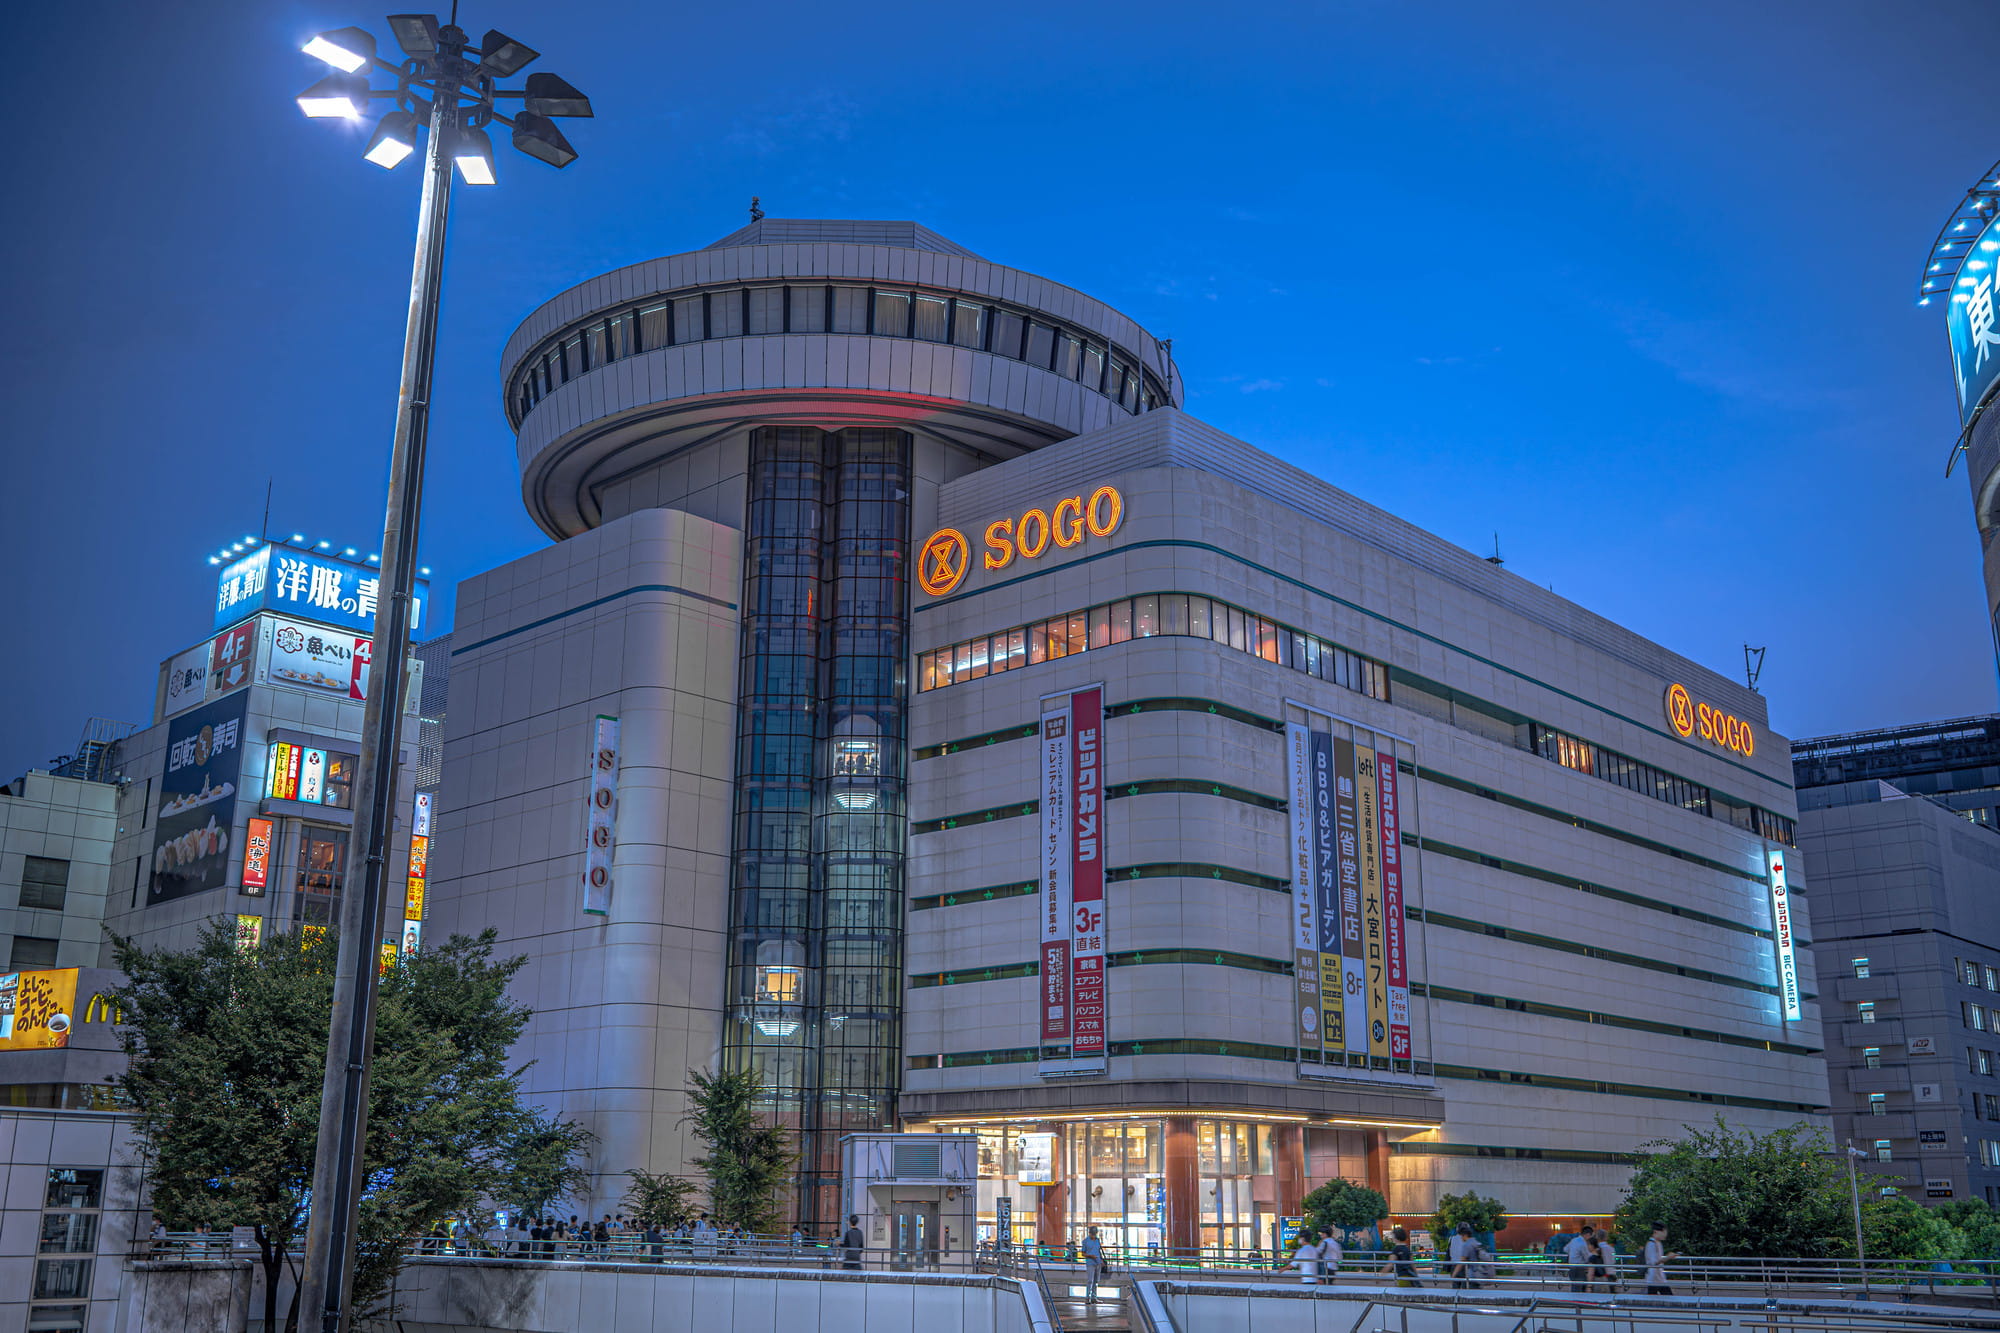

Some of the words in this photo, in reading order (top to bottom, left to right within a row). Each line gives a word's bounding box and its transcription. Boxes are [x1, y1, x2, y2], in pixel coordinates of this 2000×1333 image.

[984, 485, 1124, 570] SOGO
[218, 566, 266, 612] 洋服の青山
[221, 631, 246, 664] 4F
[308, 635, 352, 660] 魚べい
[184, 667, 206, 690] 魚べい
[1698, 702, 1754, 757] SOGO
[169, 735, 198, 773] 回転
[211, 718, 240, 757] 寿司
[1078, 728, 1097, 862] ビックカメラ
[590, 749, 616, 888] SOGO
[1381, 762, 1397, 864] ビックカメラ
[248, 836, 266, 873] 北海道
[411, 848, 424, 873] 北海道
[1317, 751, 1336, 949] BBQ&ビアガーデン
[1339, 804, 1360, 941] 三省堂書店
[1076, 907, 1101, 933] 3F
[1777, 900, 1790, 948] ビックカメラ
[1076, 936, 1100, 951] 直結
[1366, 893, 1383, 1009] 大宮ロフト
[1783, 954, 1792, 973] BIC
[1075, 976, 1102, 986] エアコン
[1346, 971, 1362, 996] 8F
[1785, 971, 1796, 1010] CAMERA
[20, 988, 53, 1016] コーヒー
[1078, 991, 1099, 1001] テレビ
[1392, 1001, 1406, 1011] Free
[1075, 1006, 1102, 1016] パソコン
[1075, 1035, 1102, 1045] おもちゃ
[1078, 1021, 1099, 1031] スマホ
[1393, 1035, 1408, 1054] 3F
